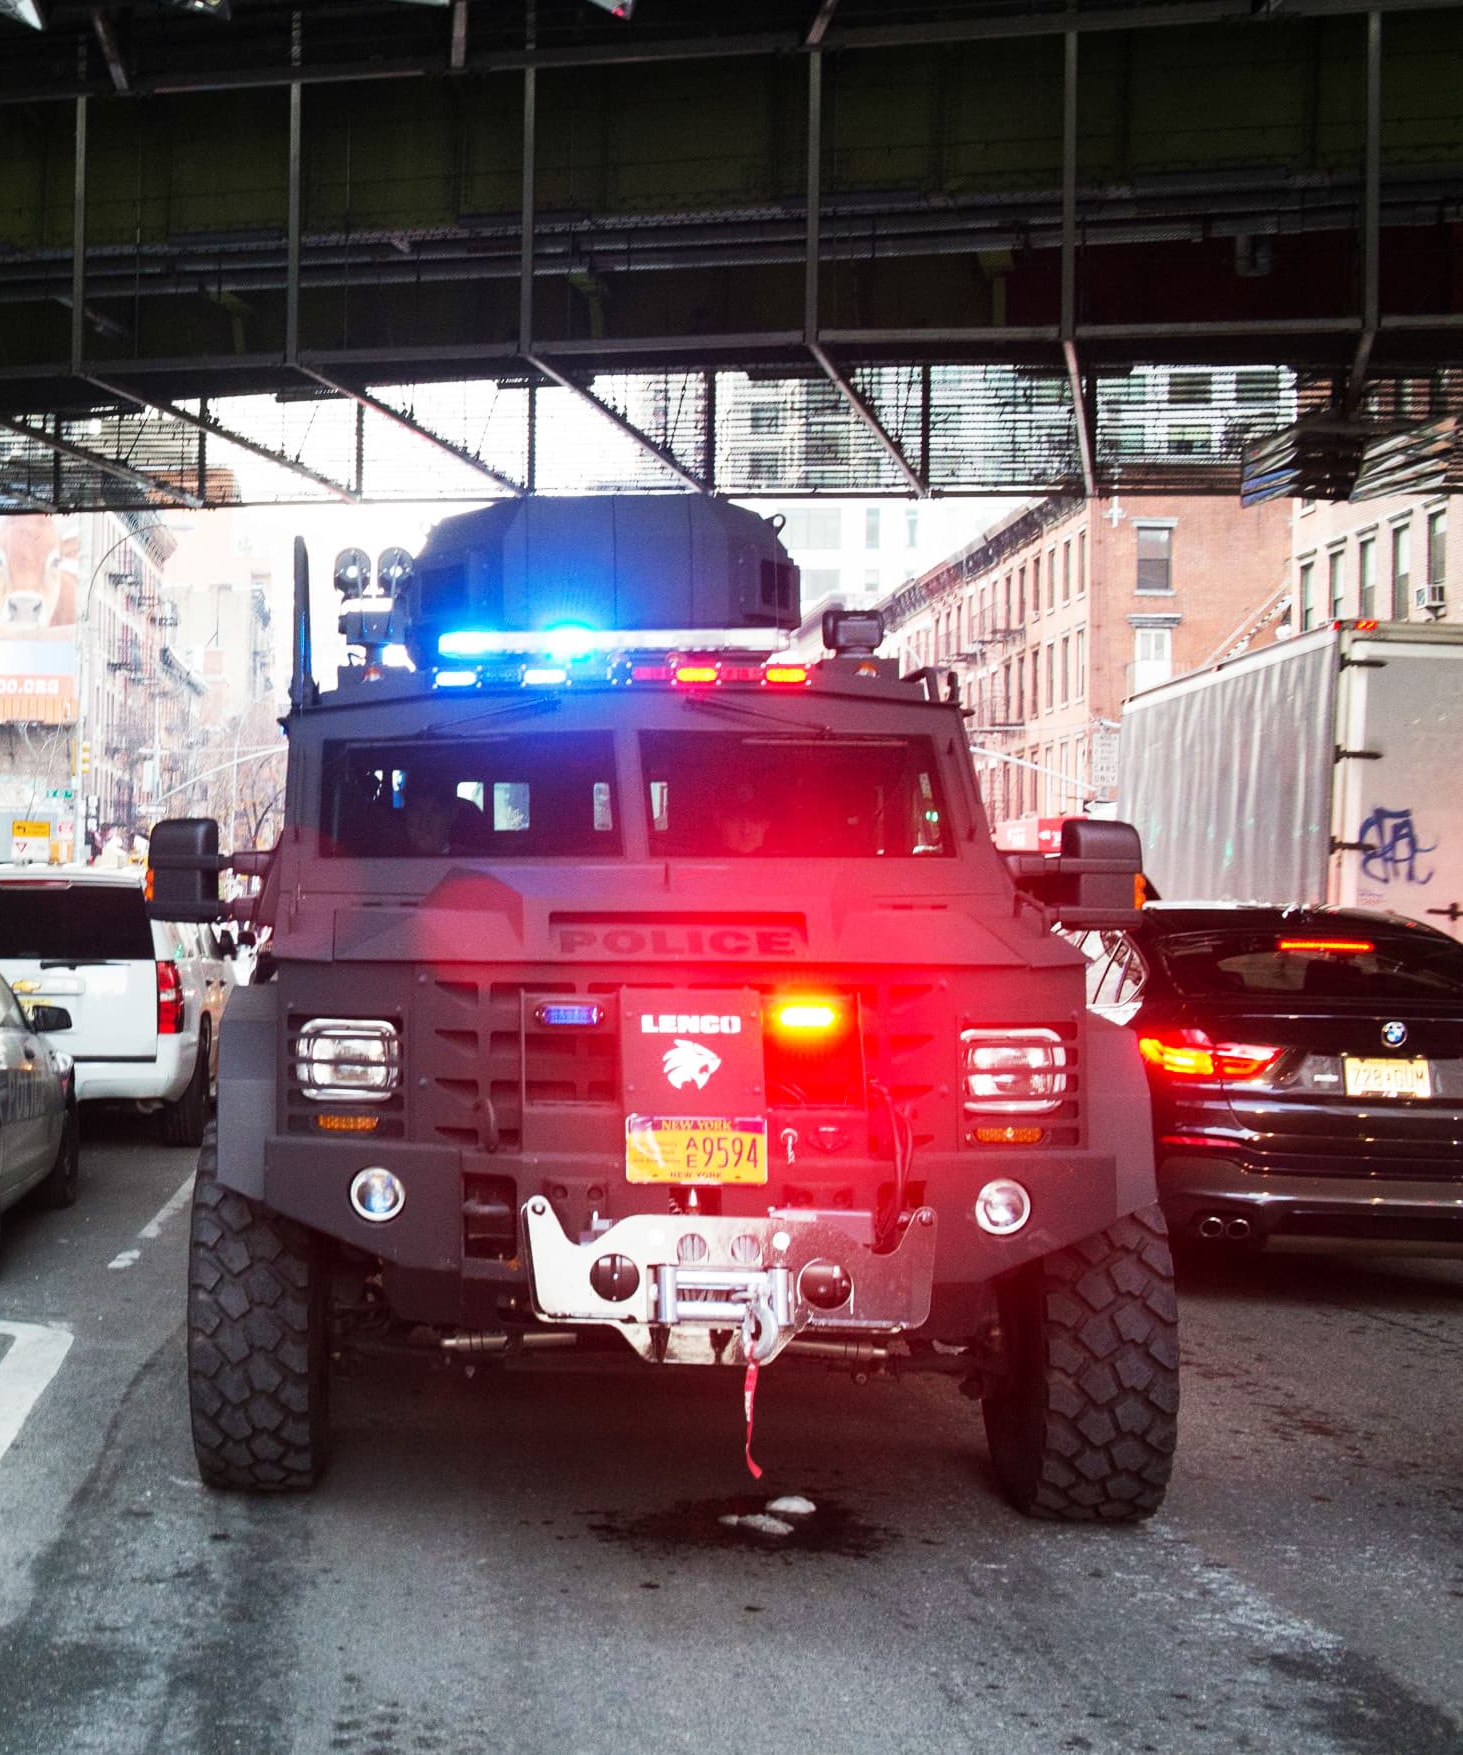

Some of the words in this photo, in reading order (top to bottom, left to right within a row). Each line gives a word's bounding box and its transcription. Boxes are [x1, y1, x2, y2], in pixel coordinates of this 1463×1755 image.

[558, 929, 796, 955] POLICE
[641, 1014, 742, 1034] LENCO
[661, 1119, 693, 1131] NEW
[697, 1119, 732, 1131] YORK
[702, 1136, 758, 1169] 9594
